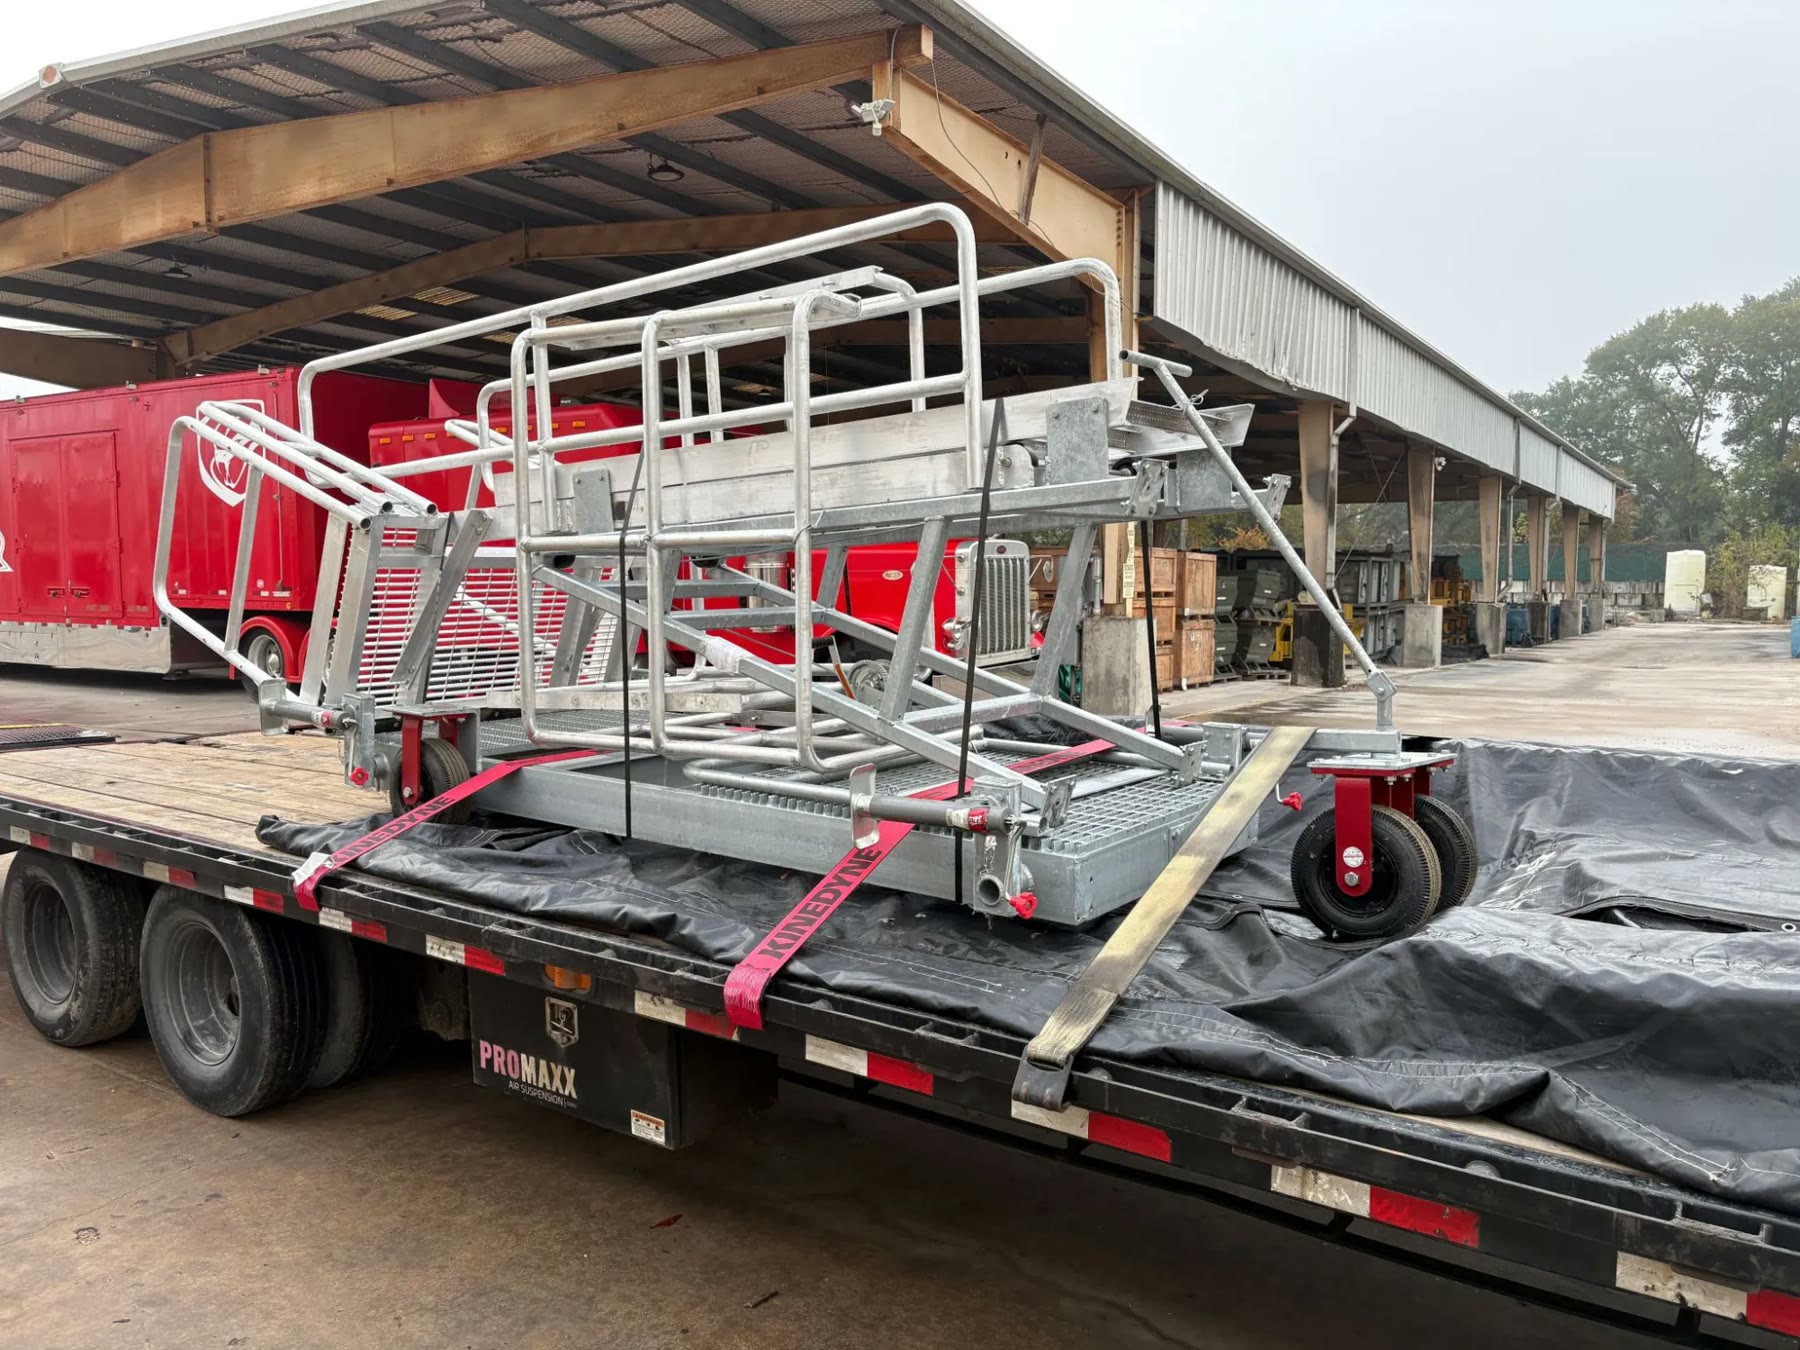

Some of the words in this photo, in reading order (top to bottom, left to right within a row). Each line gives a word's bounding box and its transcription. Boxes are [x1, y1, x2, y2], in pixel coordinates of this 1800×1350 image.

[331, 796, 455, 864] KINEDYNE
[757, 848, 883, 960] KINEDYNE
[479, 1039, 578, 1099] PROMAXX
[508, 1080, 520, 1092] AIR
[520, 1084, 564, 1107] SUSPENSION
